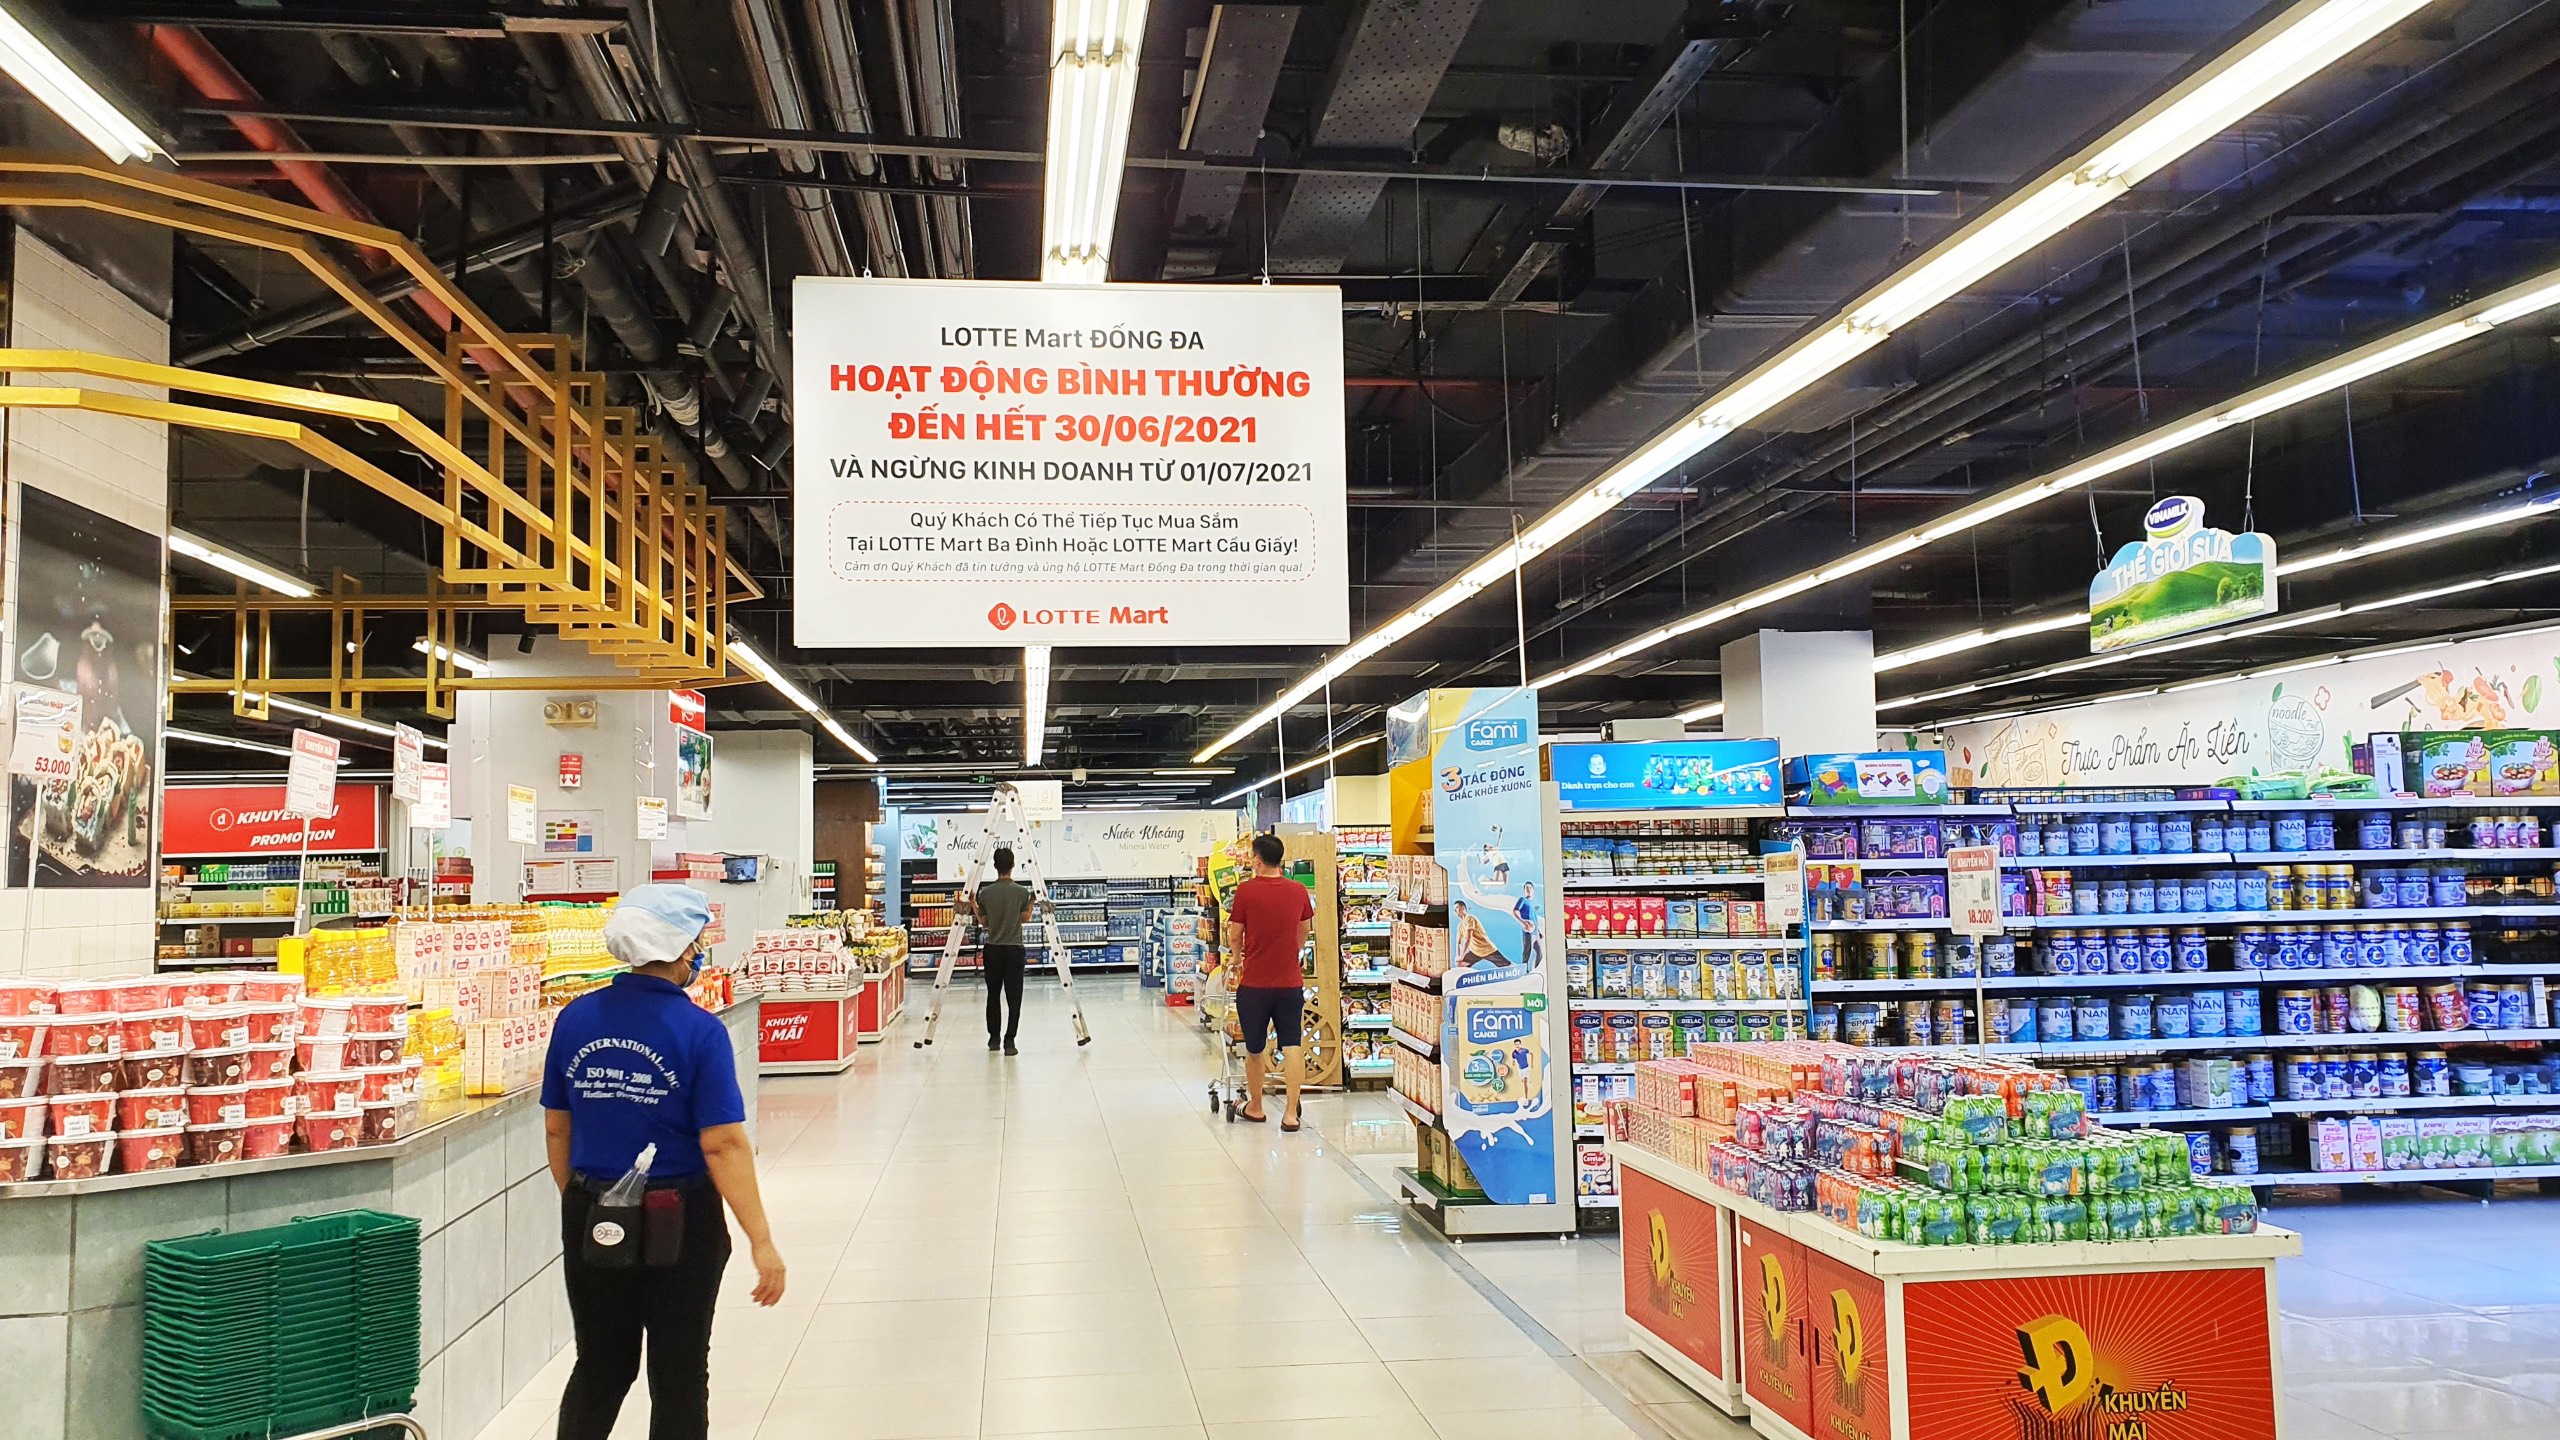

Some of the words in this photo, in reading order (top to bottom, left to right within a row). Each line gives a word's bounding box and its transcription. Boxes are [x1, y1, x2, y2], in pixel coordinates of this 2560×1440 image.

[941, 327, 1017, 347] LOTTE
[1025, 328, 1082, 348] Mart
[1090, 323, 1163, 349] ĐỐNG
[1169, 331, 1204, 350] ĐA
[830, 364, 932, 400] HOẠT
[940, 360, 1048, 401] ĐỘNG
[1058, 361, 1146, 396] BÌNH
[1155, 364, 1310, 398] THƯỜNG
[888, 402, 965, 440] ĐẾN
[976, 404, 1046, 441] HẾT
[1055, 414, 1256, 447] 30/06/2021
[830, 454, 864, 478] VÀ
[871, 454, 966, 479] NGỪNG
[974, 460, 1036, 480] KINH
[1044, 461, 1133, 481] DOANH
[1140, 458, 1175, 481] TỪ
[1180, 462, 1311, 485] 01/07/2021
[910, 512, 946, 531] Quý
[952, 512, 1009, 527] Khách
[1014, 513, 1037, 528] Có
[1042, 511, 1075, 528] Thể
[1079, 512, 1117, 531] Tiếp
[1121, 514, 1153, 532] Tục
[1159, 514, 1195, 529] Mua
[1200, 512, 1239, 529] Sắm
[2149, 503, 2188, 526] VINAMILK
[847, 536, 873, 554] Tại
[879, 537, 935, 551] LOTTE
[941, 537, 983, 552] Mart
[988, 538, 1010, 552] Ba
[1015, 536, 1057, 552] Đình
[1064, 537, 1108, 556] Hoặc
[1113, 538, 1167, 552] LOTTE
[1172, 538, 1212, 552] Mart
[1217, 536, 1250, 553] Cầu
[1255, 536, 1298, 556] Giấy!
[917, 561, 952, 572] Khách
[972, 562, 987, 572] tin
[1083, 562, 1117, 572] LOTTE
[1119, 563, 1144, 572] Mart
[1180, 563, 1194, 572] Đa
[1197, 563, 1226, 574] trong
[1253, 563, 1276, 574] gian
[1279, 563, 1303, 574] qua!
[1022, 610, 1100, 625] LOTTE
[1109, 606, 1168, 624] Mart
[2061, 740, 2101, 776] Thực
[2107, 727, 2161, 771] Phẩm
[2168, 721, 2200, 769] Ăn
[2207, 717, 2251, 765] Liền
[35, 756, 71, 775] 53.000
[1441, 766, 1464, 793] 3
[1463, 772, 1487, 786] TÁC
[1490, 766, 1525, 782] ĐỘNG
[1500, 780, 1532, 793] XƯƠNG
[946, 834, 979, 850] Nước
[1102, 823, 1136, 840] Nước
[1139, 825, 1185, 843] Khoáng
[1967, 909, 1993, 924] 18.200
[1462, 974, 1486, 985] PHIÊN
[2191, 999, 2222, 1009] NAN
[766, 1014, 808, 1027] KHUYẾN
[770, 1025, 804, 1042] MÃI
[586, 1067, 605, 1078] ISO
[2104, 1379, 2187, 1414] KHUYẾN
[2108, 1416, 2147, 1440] MÃI
